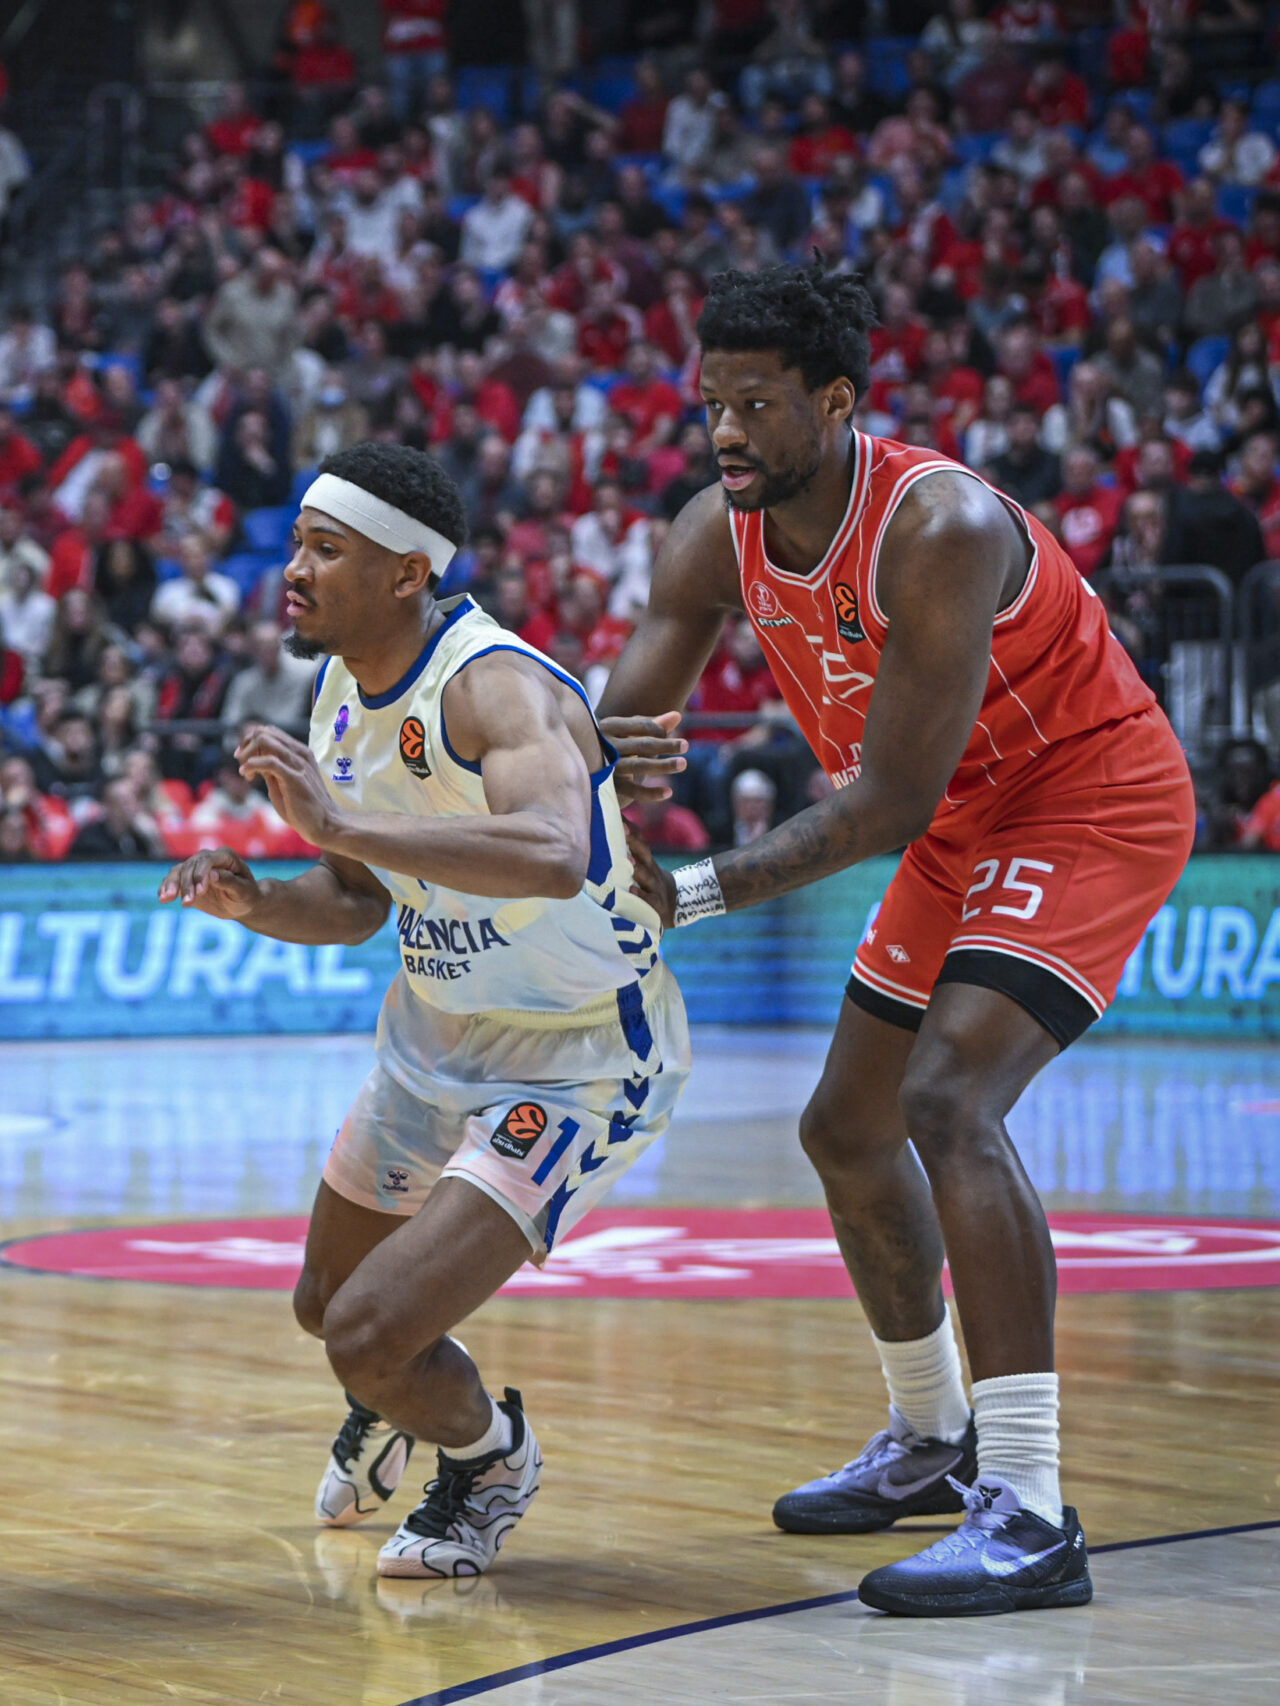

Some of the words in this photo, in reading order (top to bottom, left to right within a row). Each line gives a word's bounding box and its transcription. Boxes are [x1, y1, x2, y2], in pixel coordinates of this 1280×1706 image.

[962, 857, 1054, 920] 25
[404, 953, 472, 980] BASKET
[531, 1116, 581, 1187] 1
